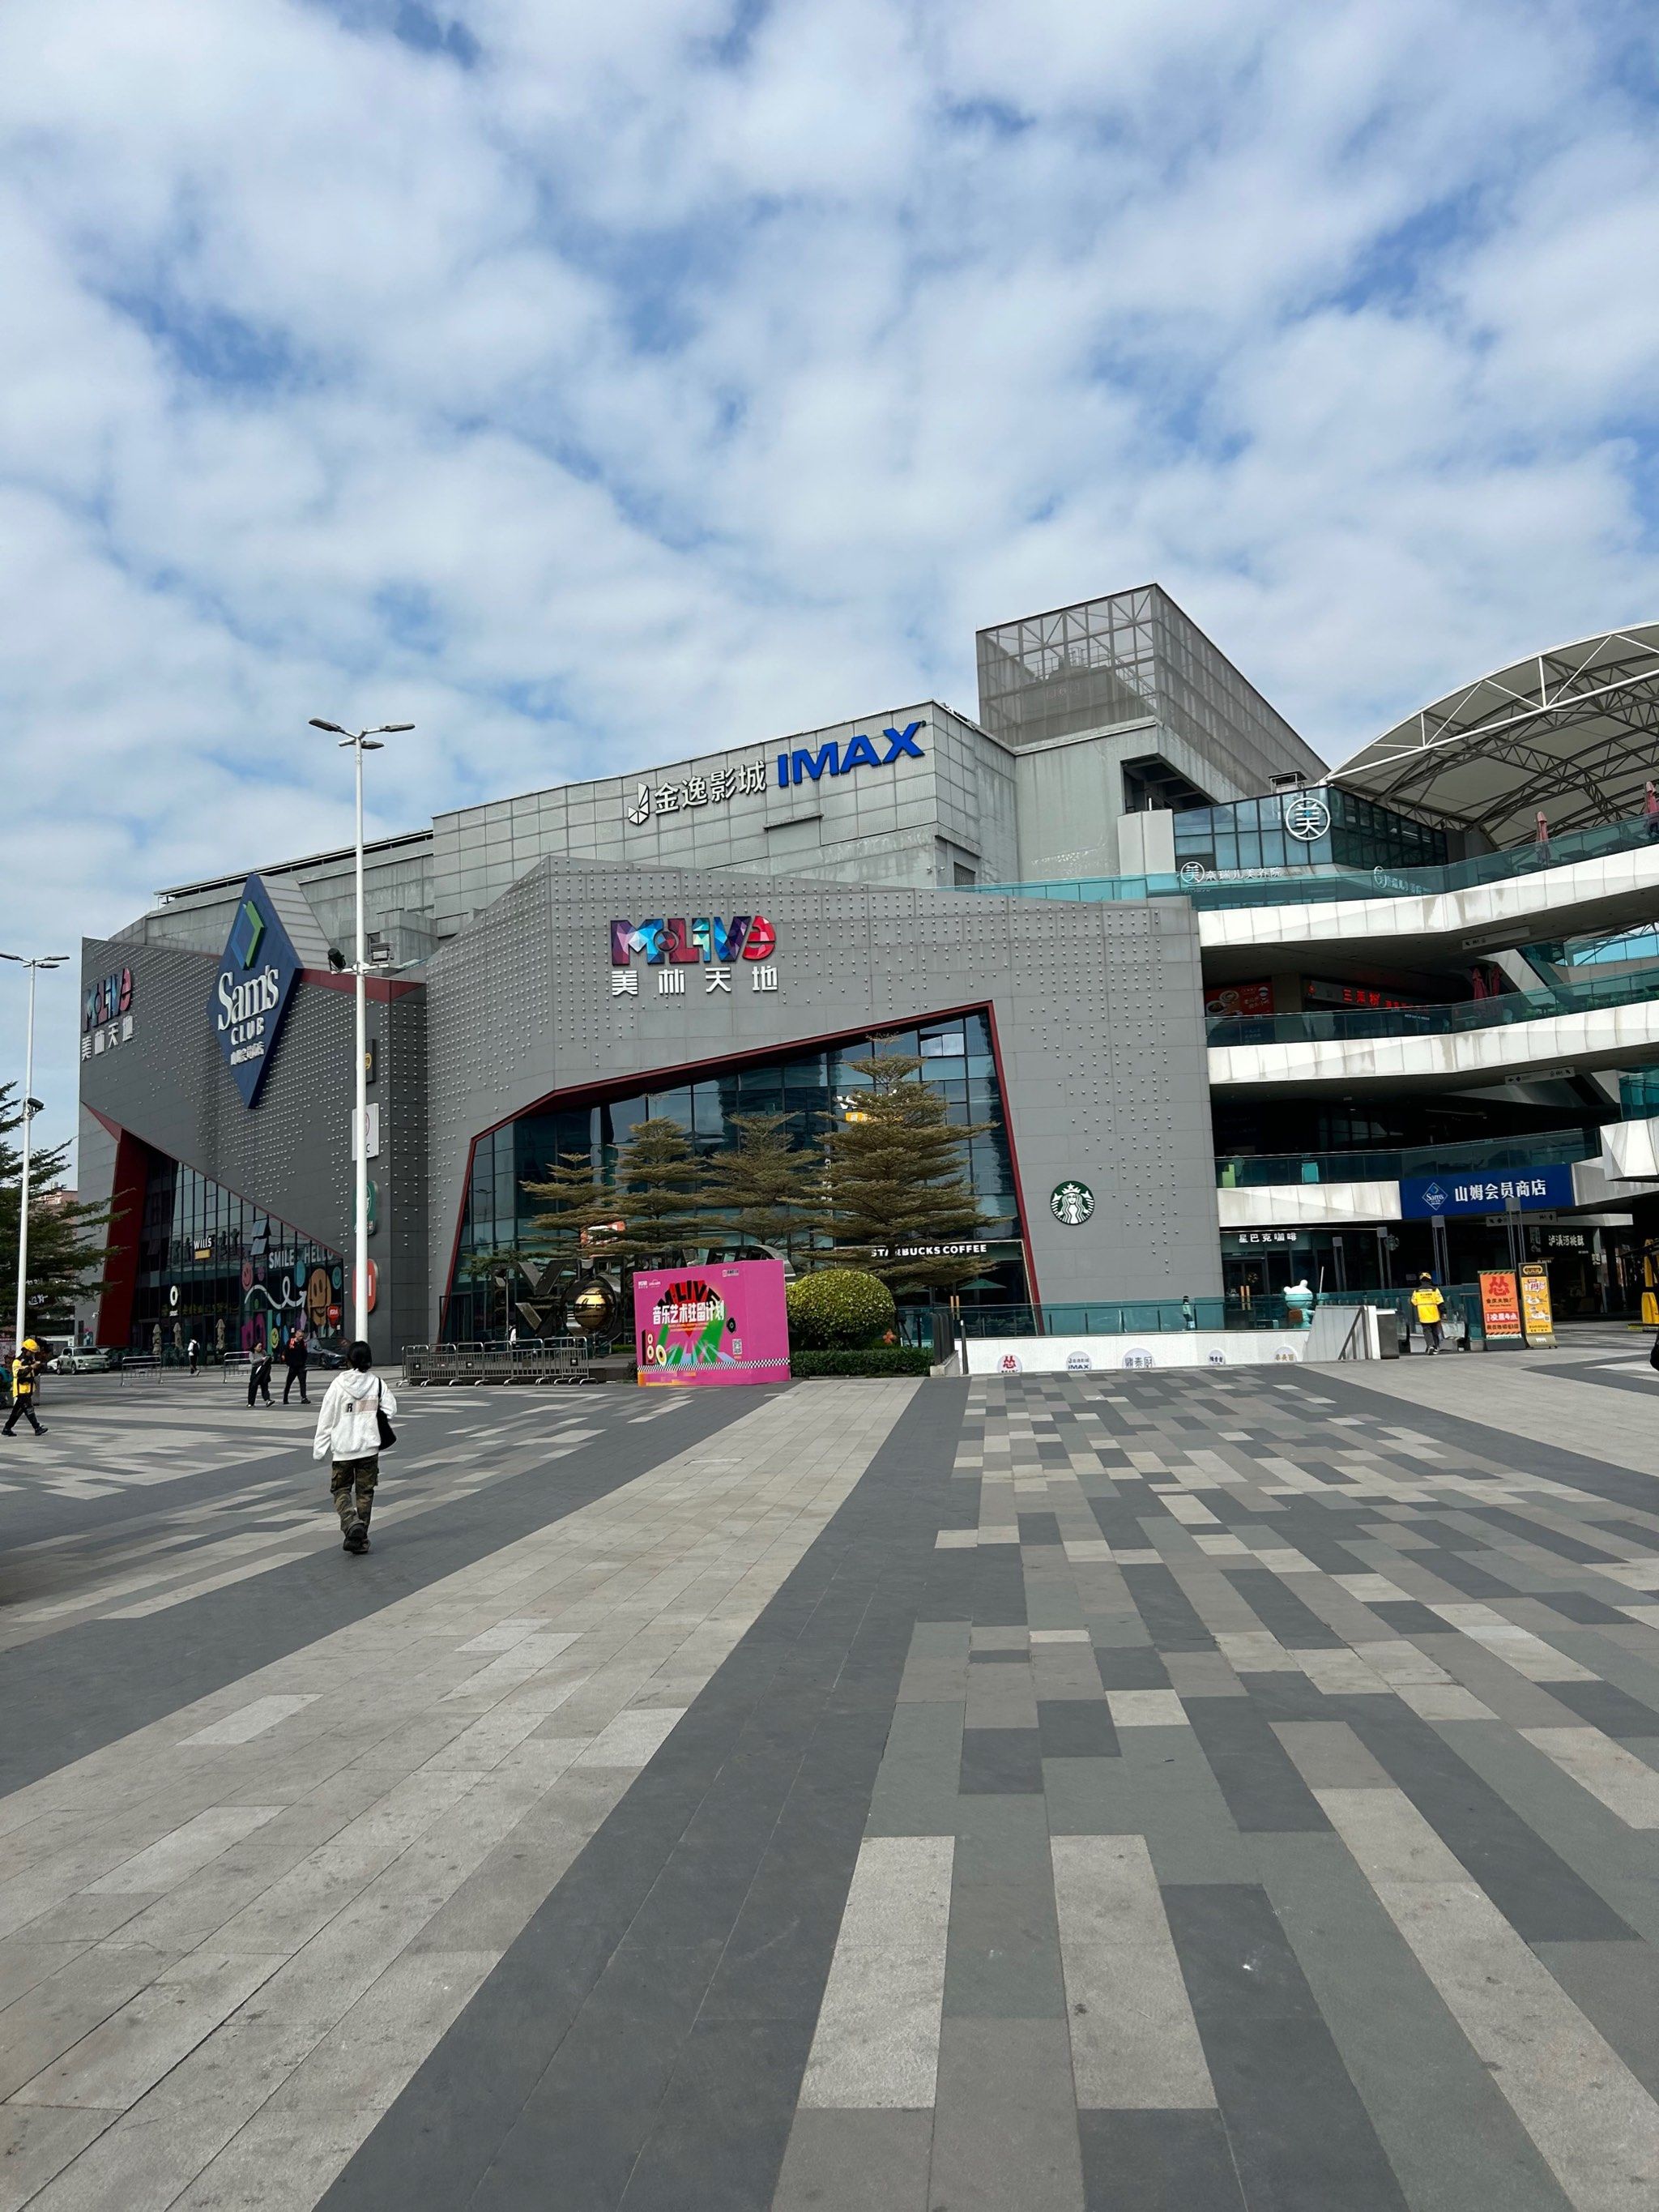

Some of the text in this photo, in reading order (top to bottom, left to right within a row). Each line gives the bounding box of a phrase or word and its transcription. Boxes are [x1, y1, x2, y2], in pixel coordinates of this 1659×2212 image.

[778, 720, 924, 788] IMAX
[655, 760, 766, 814] 金逸影城
[611, 965, 778, 996] 美林天地
[217, 964, 279, 1031] Sam's
[230, 1017, 265, 1045] CLUB
[1455, 1179, 1546, 1202] 山姆会员商店
[942, 1244, 987, 1254] COFFEE
[1239, 1232, 1298, 1244] 星巴克咖啡
[268, 1249, 295, 1270] SMILE
[652, 1300, 725, 1326] 音乐艺术驻留计划
